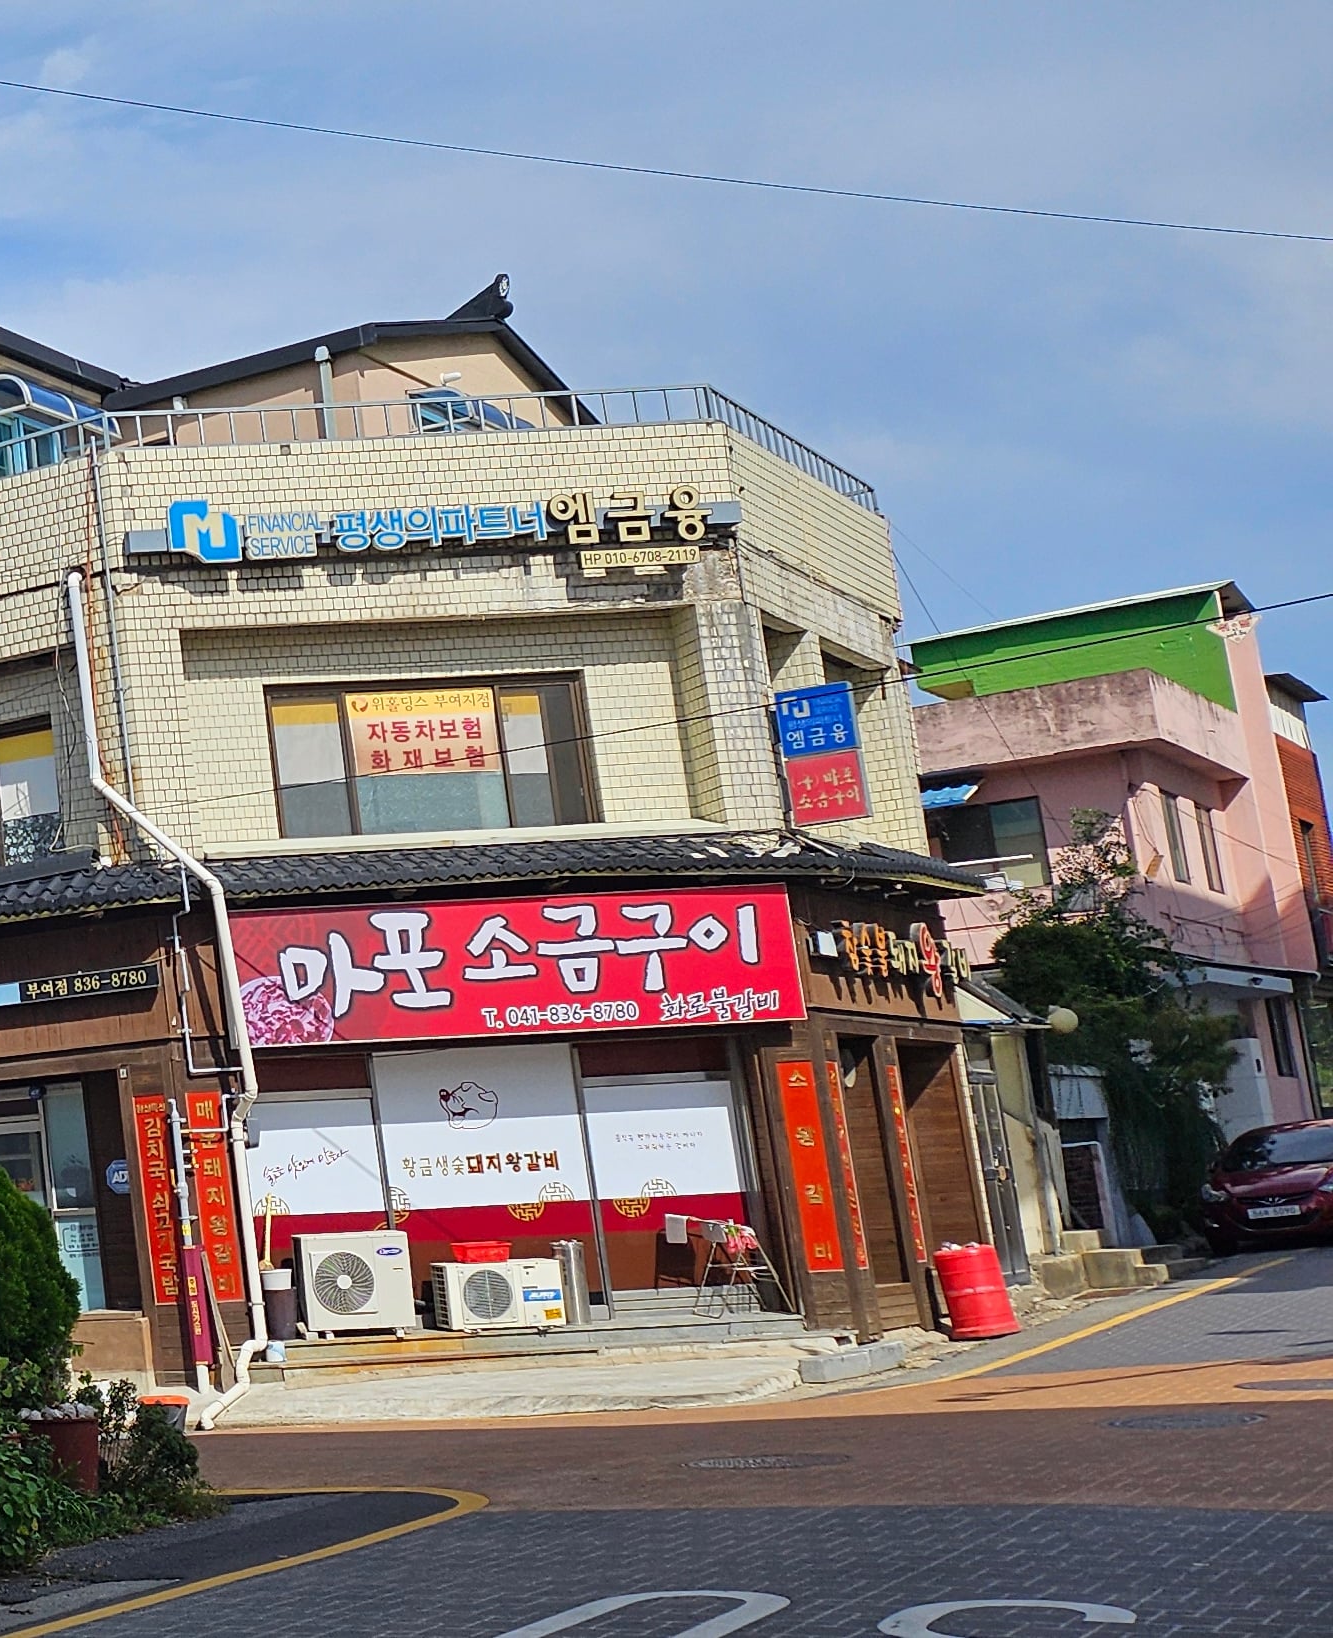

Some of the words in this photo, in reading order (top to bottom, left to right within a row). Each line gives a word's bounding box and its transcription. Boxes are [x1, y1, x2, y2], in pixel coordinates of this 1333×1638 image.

[246, 512, 325, 533] FINANCIAL
[249, 535, 316, 557] SERVICE
[583, 553, 602, 567] HP
[604, 548, 697, 565] 010-6708-2119
[433, 692, 490, 708] 부여지점
[367, 716, 483, 744] 자동차보험
[786, 723, 849, 750] 엠금융
[278, 911, 452, 1018] 마포
[463, 903, 761, 994] 소금구이
[26, 978, 69, 1000] 부여점
[73, 970, 147, 993] 836-8780
[111, 1170, 130, 1185] AD
